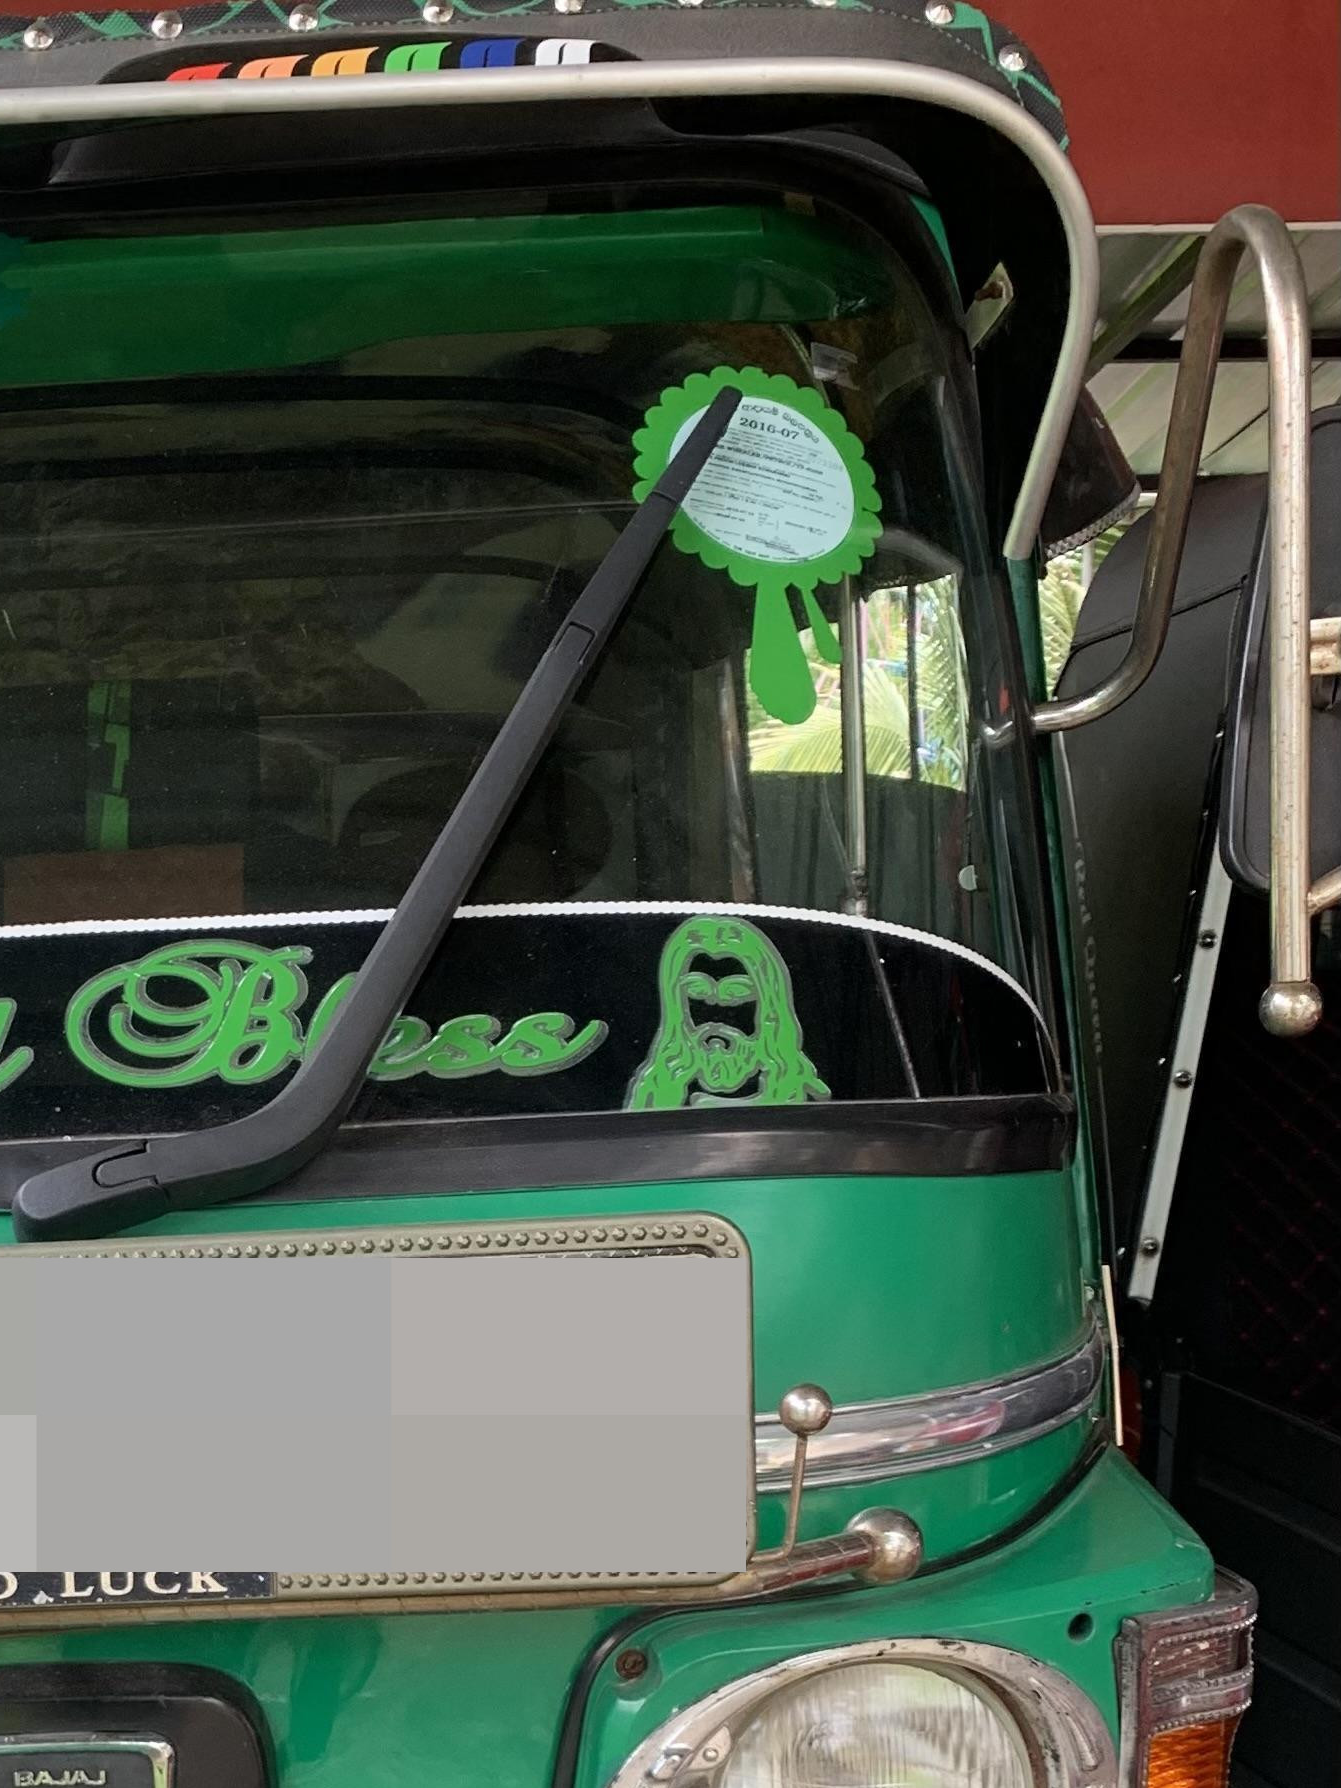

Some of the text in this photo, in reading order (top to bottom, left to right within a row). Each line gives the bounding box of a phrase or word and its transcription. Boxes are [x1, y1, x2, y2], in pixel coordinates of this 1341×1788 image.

[740, 417, 800, 440] 2016-07
[60, 1571, 229, 1598] LUCK
[13, 1769, 106, 1787] BAJAJ
